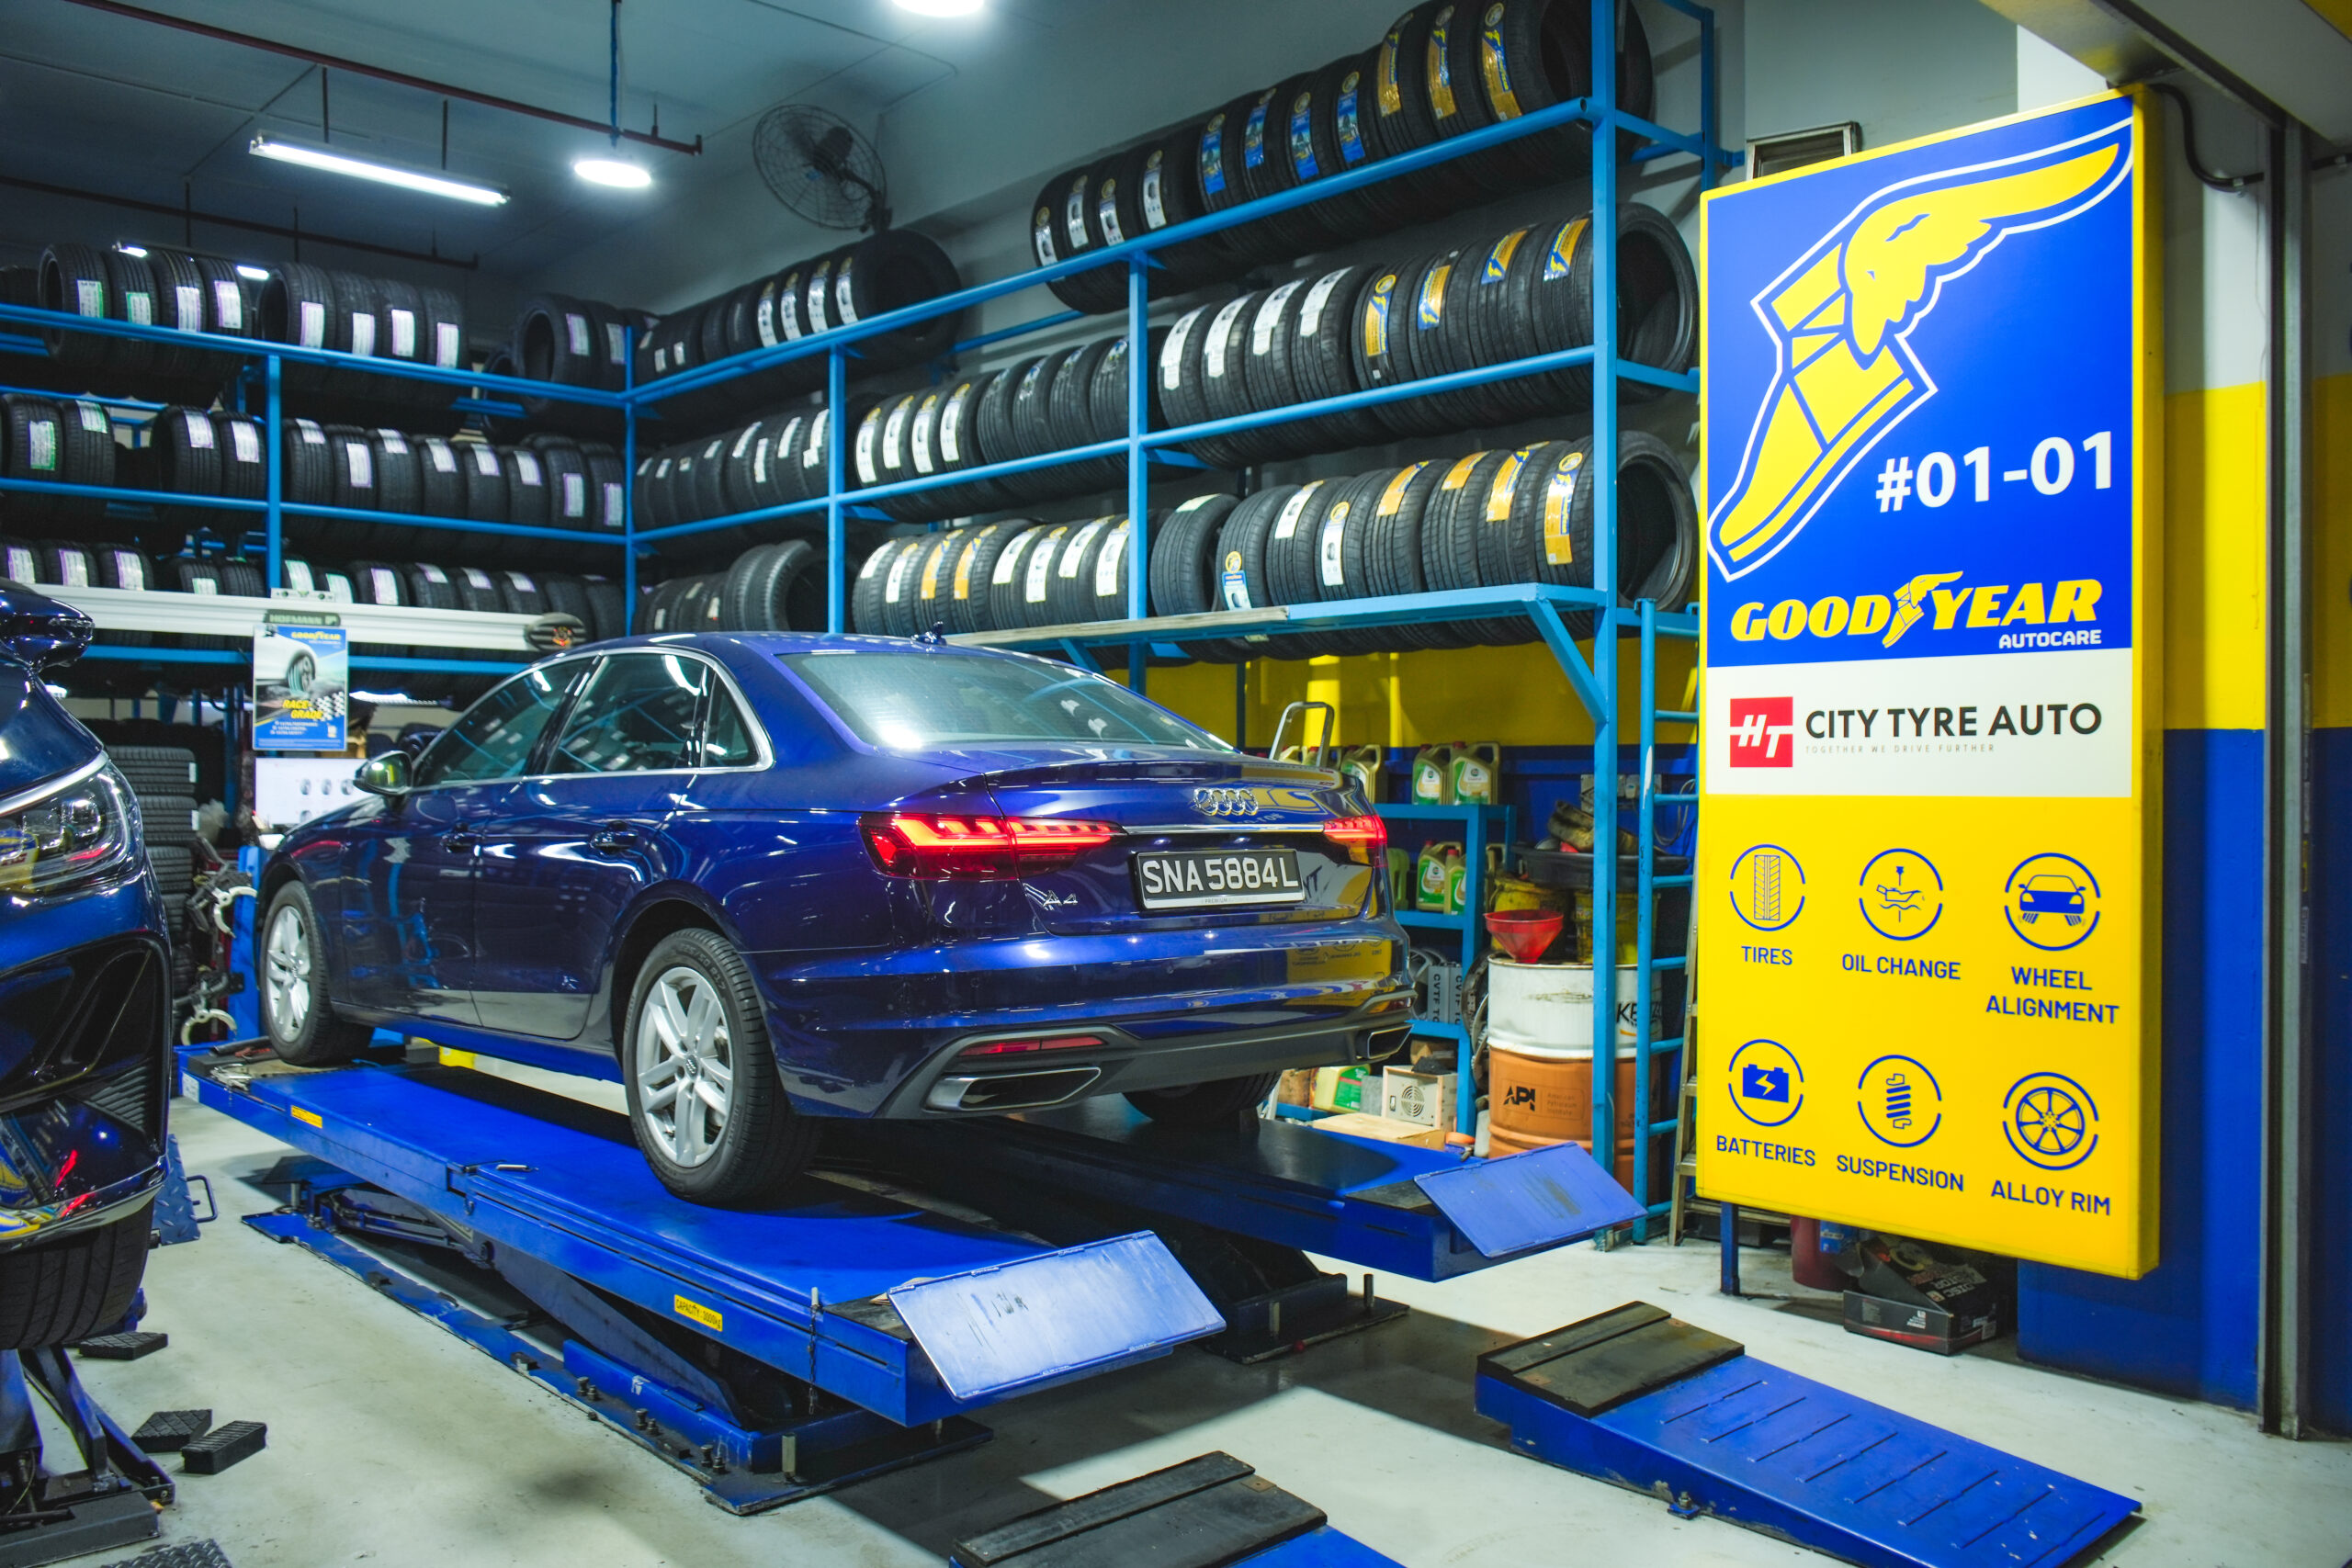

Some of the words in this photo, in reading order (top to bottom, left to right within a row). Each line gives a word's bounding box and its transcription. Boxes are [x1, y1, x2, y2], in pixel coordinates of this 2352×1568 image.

[1875, 431, 2111, 513] #01-01
[1731, 573, 2103, 646] GOODYEAR
[1999, 629, 2102, 649] AUTOCARE
[1806, 709, 1879, 739] CITY
[1887, 705, 1977, 737] TYRE
[1988, 703, 2102, 736] AUTO
[1737, 715, 1789, 759] HT
[1805, 745, 1863, 753] TOGETHER
[1939, 744, 1995, 752] FURTHER
[1043, 890, 1079, 906] A4
[1741, 945, 1792, 965] TIRES
[1842, 953, 1871, 974] OIL
[1876, 955, 1961, 980] CHANGE
[2011, 965, 2092, 990] WHEEL
[1985, 995, 2120, 1024] ALIGNMENT
[1503, 1086, 1535, 1111] API
[1716, 1134, 1815, 1167] BATTERIES
[1837, 1155, 1963, 1191] SUSPENSION
[1991, 1179, 2064, 1208] ALLOY
[2072, 1191, 2110, 1215] RIM
